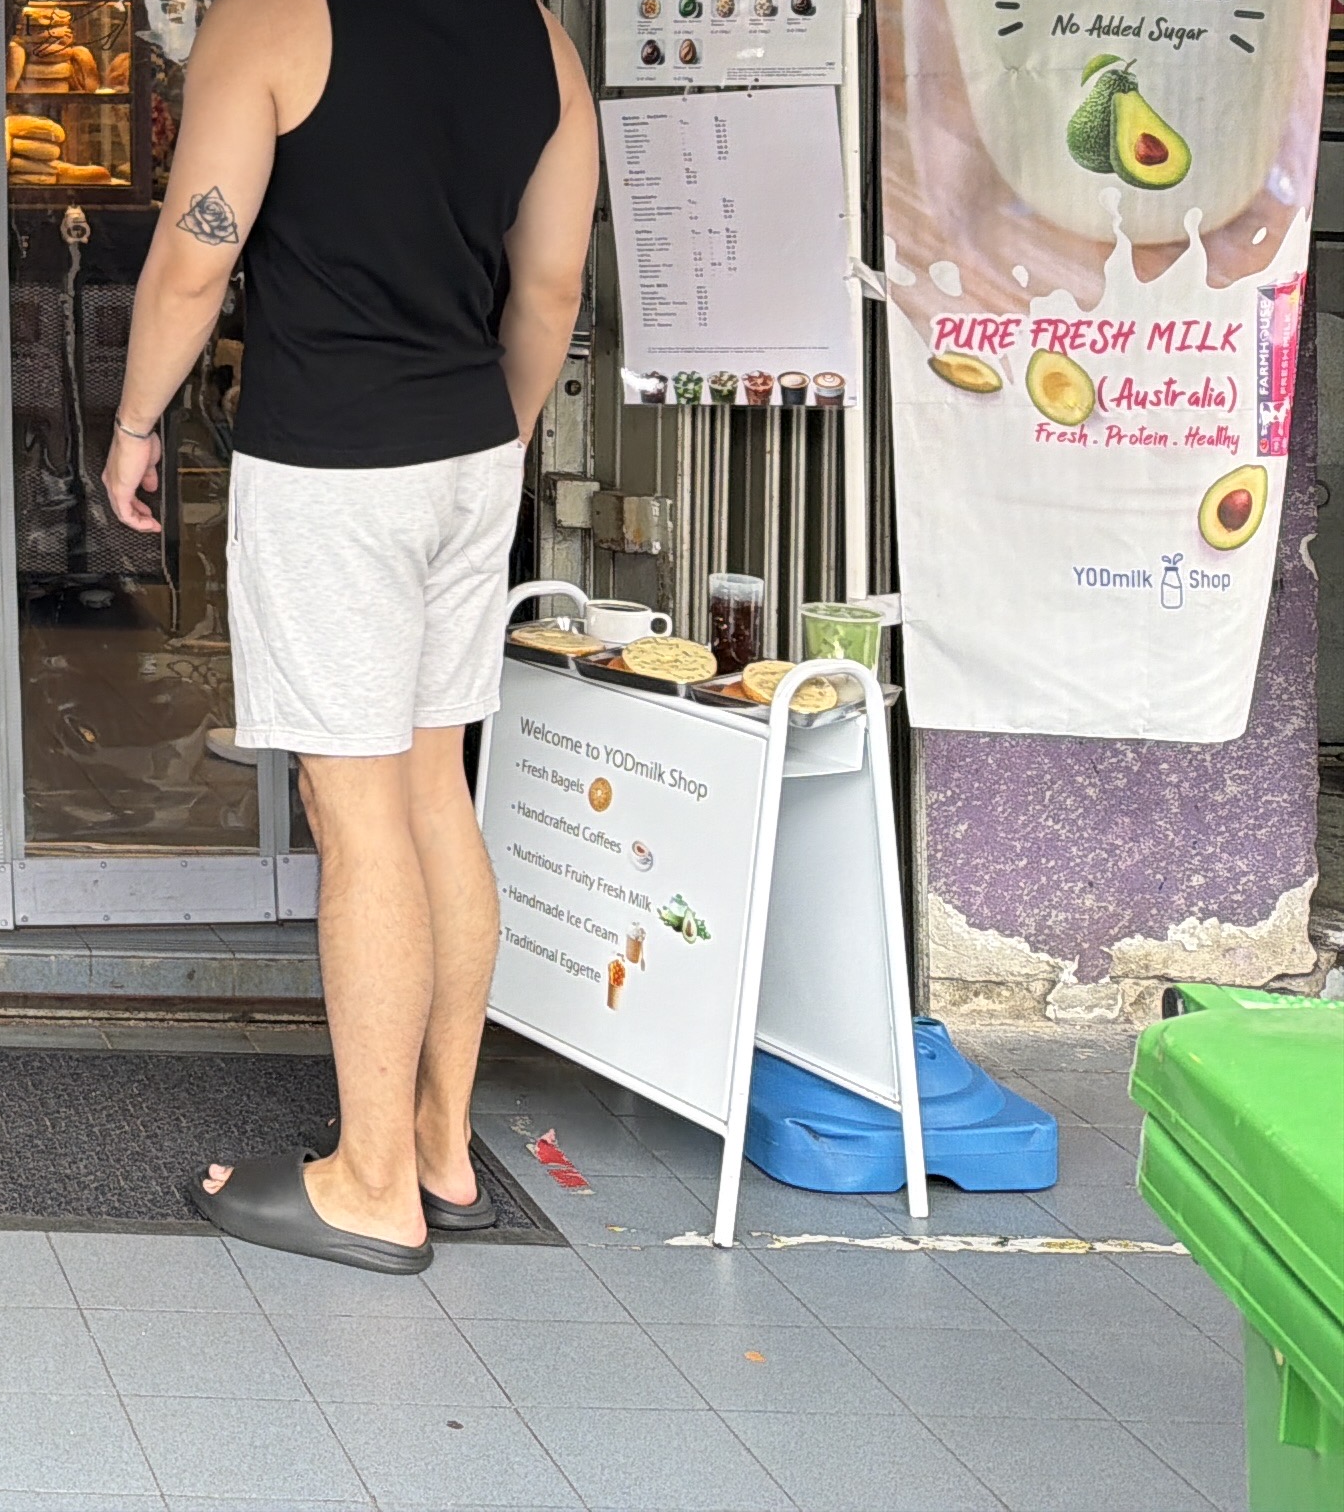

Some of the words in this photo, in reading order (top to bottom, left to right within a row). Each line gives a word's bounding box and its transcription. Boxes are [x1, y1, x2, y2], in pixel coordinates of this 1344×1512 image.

[1051, 13, 1080, 37] No
[1085, 14, 1143, 39] Added
[1148, 16, 1209, 50] Sugar
[934, 318, 1021, 354] PURE
[1030, 319, 1137, 355] FRESH
[1146, 320, 1243, 354] MILK
[1258, 300, 1271, 396] FARMHOUSE
[1097, 376, 1238, 413] (Australia)
[1035, 424, 1088, 446] Fresh
[1105, 425, 1168, 447] Protein
[1184, 427, 1241, 454] Healthy
[1073, 567, 1154, 589] YODmilk
[1189, 569, 1231, 591] Shop
[520, 716, 582, 756] Welcome
[585, 740, 600, 761] to
[604, 744, 666, 784] YODmilk
[668, 768, 709, 802] Shop
[521, 759, 549, 782] Fresh
[551, 769, 585, 796] Bagels
[517, 801, 580, 838] Handcrafted
[582, 825, 622, 855] Coffees
[512, 843, 563, 875] Nutritious
[565, 863, 596, 890] Fruity
[597, 876, 626, 901] Fresh
[628, 889, 652, 913] Milk
[508, 884, 565, 920] Handmade
[567, 908, 581, 927] Ice
[583, 918, 618, 945] Cream
[504, 927, 559, 964] Traditional
[560, 952, 601, 984] Eggette
